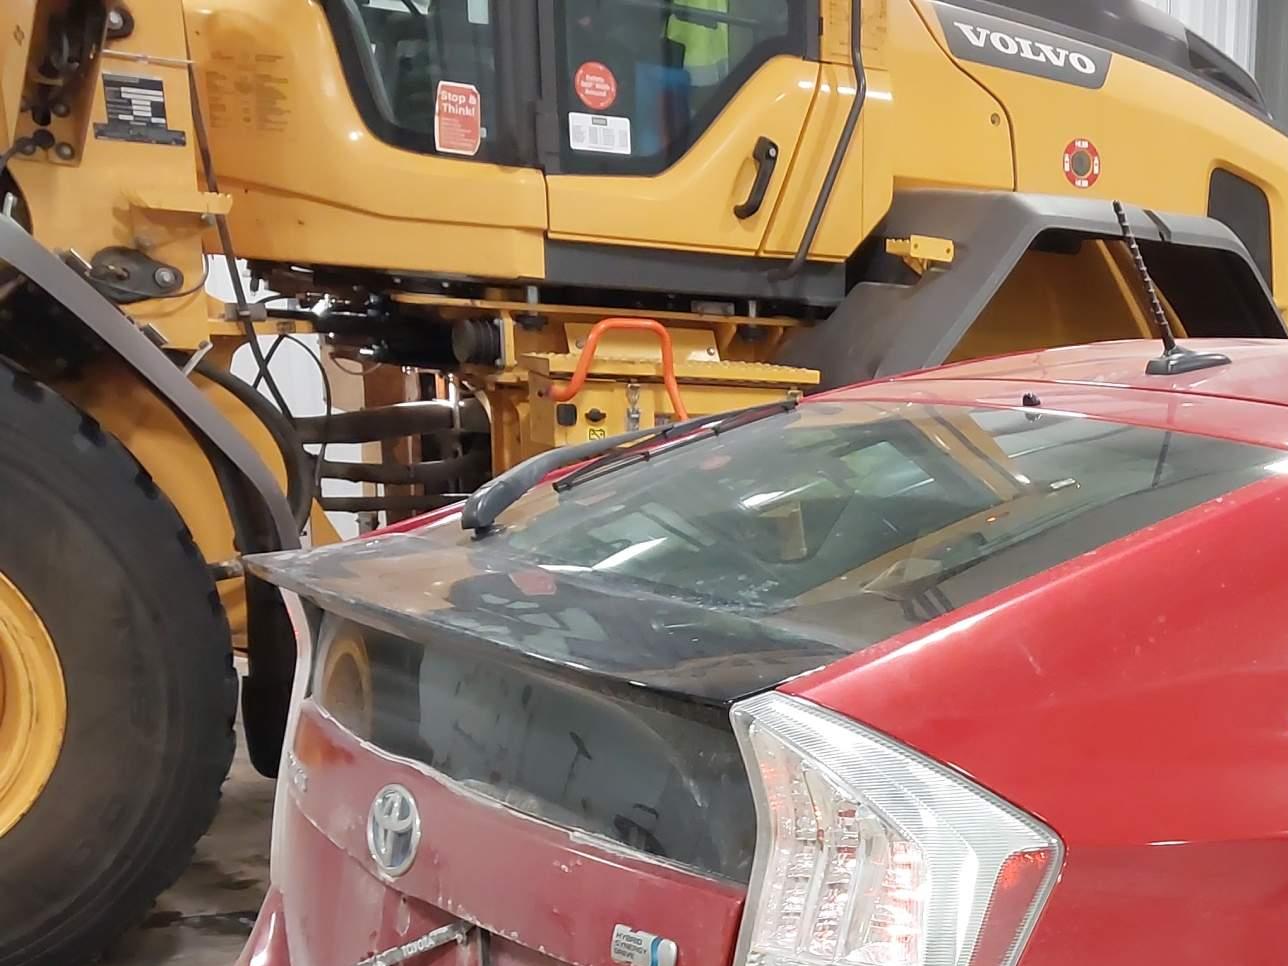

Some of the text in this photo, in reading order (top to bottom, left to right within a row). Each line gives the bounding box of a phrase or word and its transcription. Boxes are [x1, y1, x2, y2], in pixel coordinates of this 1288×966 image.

[953, 21, 1096, 75] VOLVO
[441, 90, 466, 105] Stop
[441, 102, 476, 116] Think!
